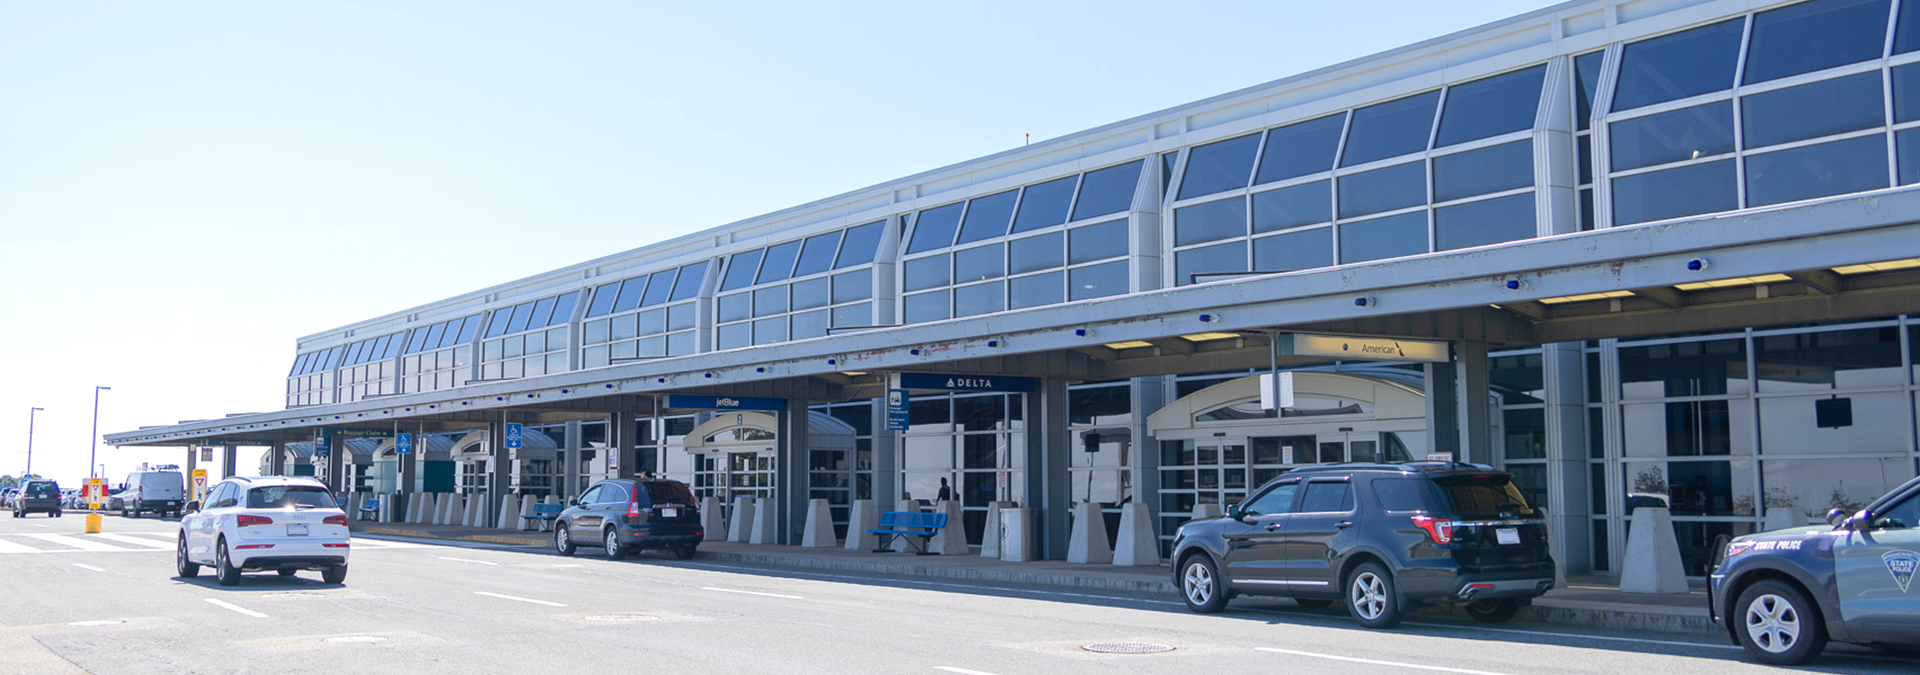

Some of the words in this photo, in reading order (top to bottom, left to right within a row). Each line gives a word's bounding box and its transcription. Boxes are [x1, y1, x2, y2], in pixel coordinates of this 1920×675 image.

[1362, 344, 1395, 354] American
[957, 378, 992, 388] DELTA
[716, 398, 739, 407] jetBlue
[1755, 540, 1775, 550] STATE
[1776, 540, 1802, 550] POLICE
